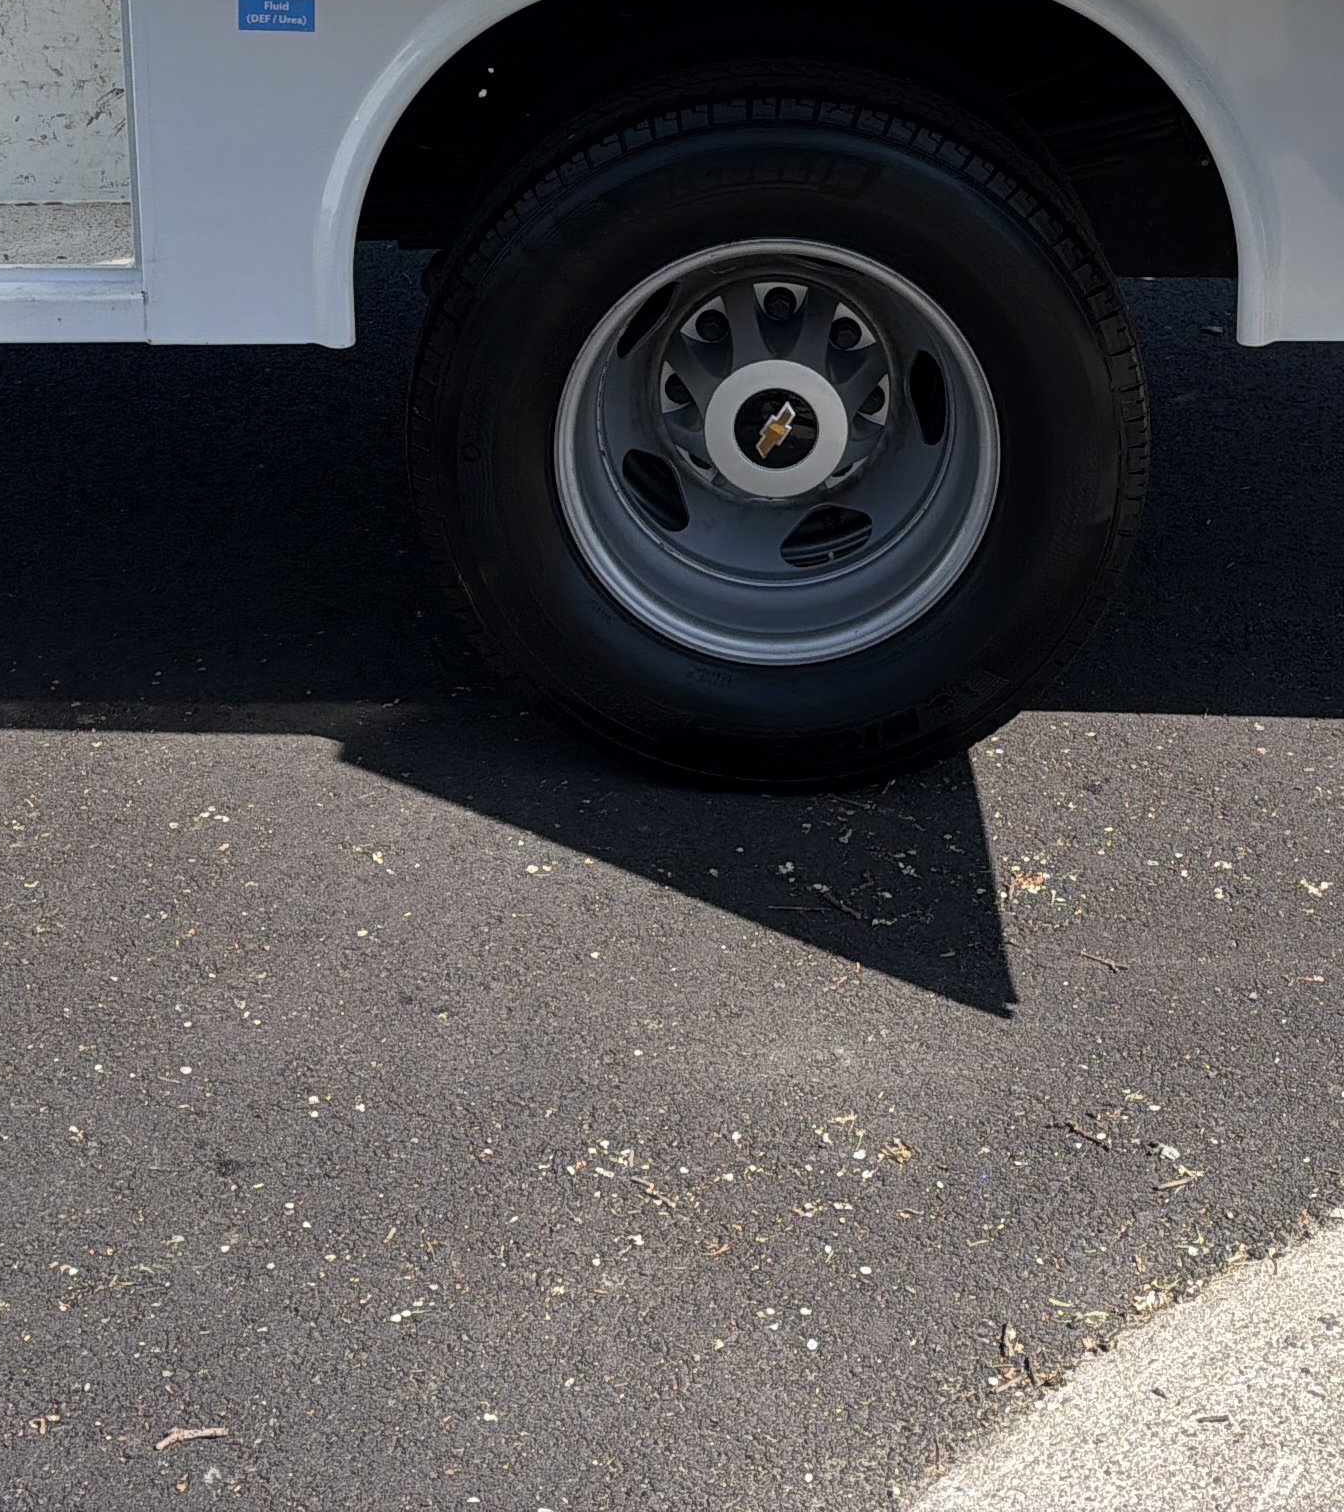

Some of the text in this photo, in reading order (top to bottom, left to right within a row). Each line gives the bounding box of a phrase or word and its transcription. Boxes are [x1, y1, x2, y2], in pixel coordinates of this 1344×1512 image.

[264, 0, 289, 11] Fluid
[246, 14, 271, 25] (DEF
[278, 15, 307, 26] Urea)
